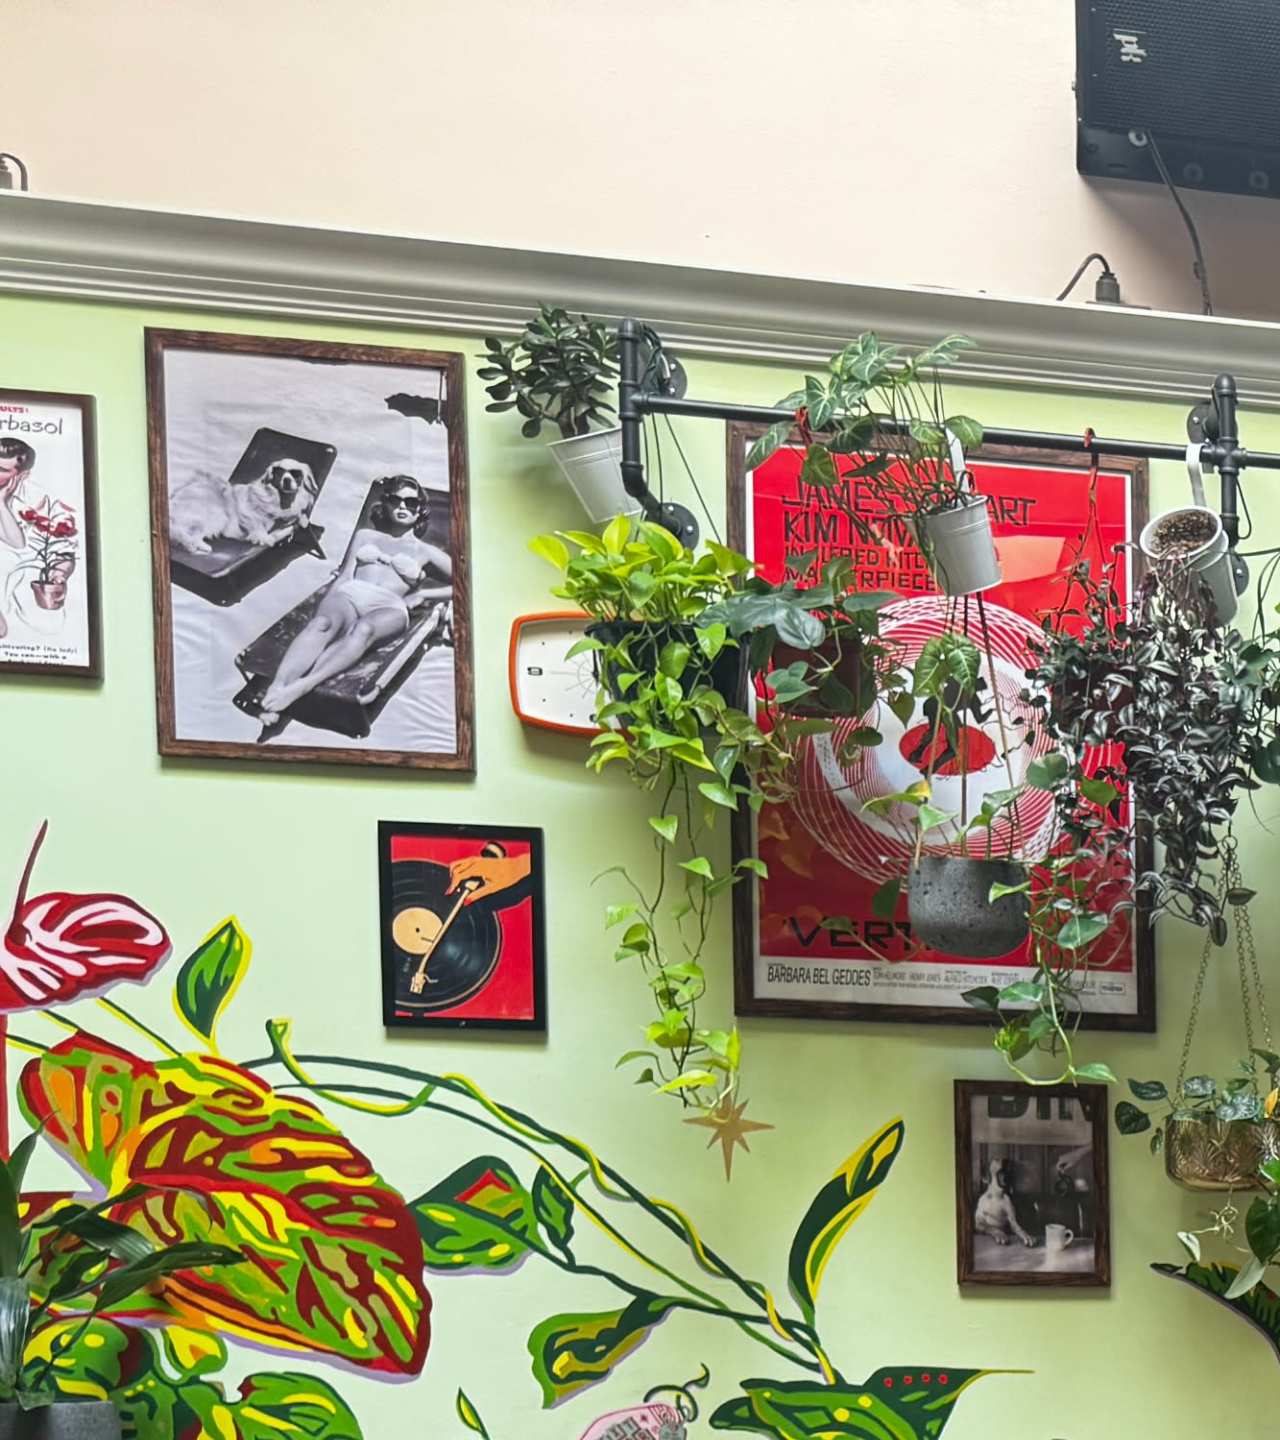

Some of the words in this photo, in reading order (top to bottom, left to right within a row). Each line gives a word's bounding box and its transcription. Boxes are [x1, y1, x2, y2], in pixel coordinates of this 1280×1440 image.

[784, 511, 838, 543] KIM
[768, 963, 811, 984] BARBARA
[813, 967, 830, 985] BEL
[832, 968, 871, 987] GEDDES
